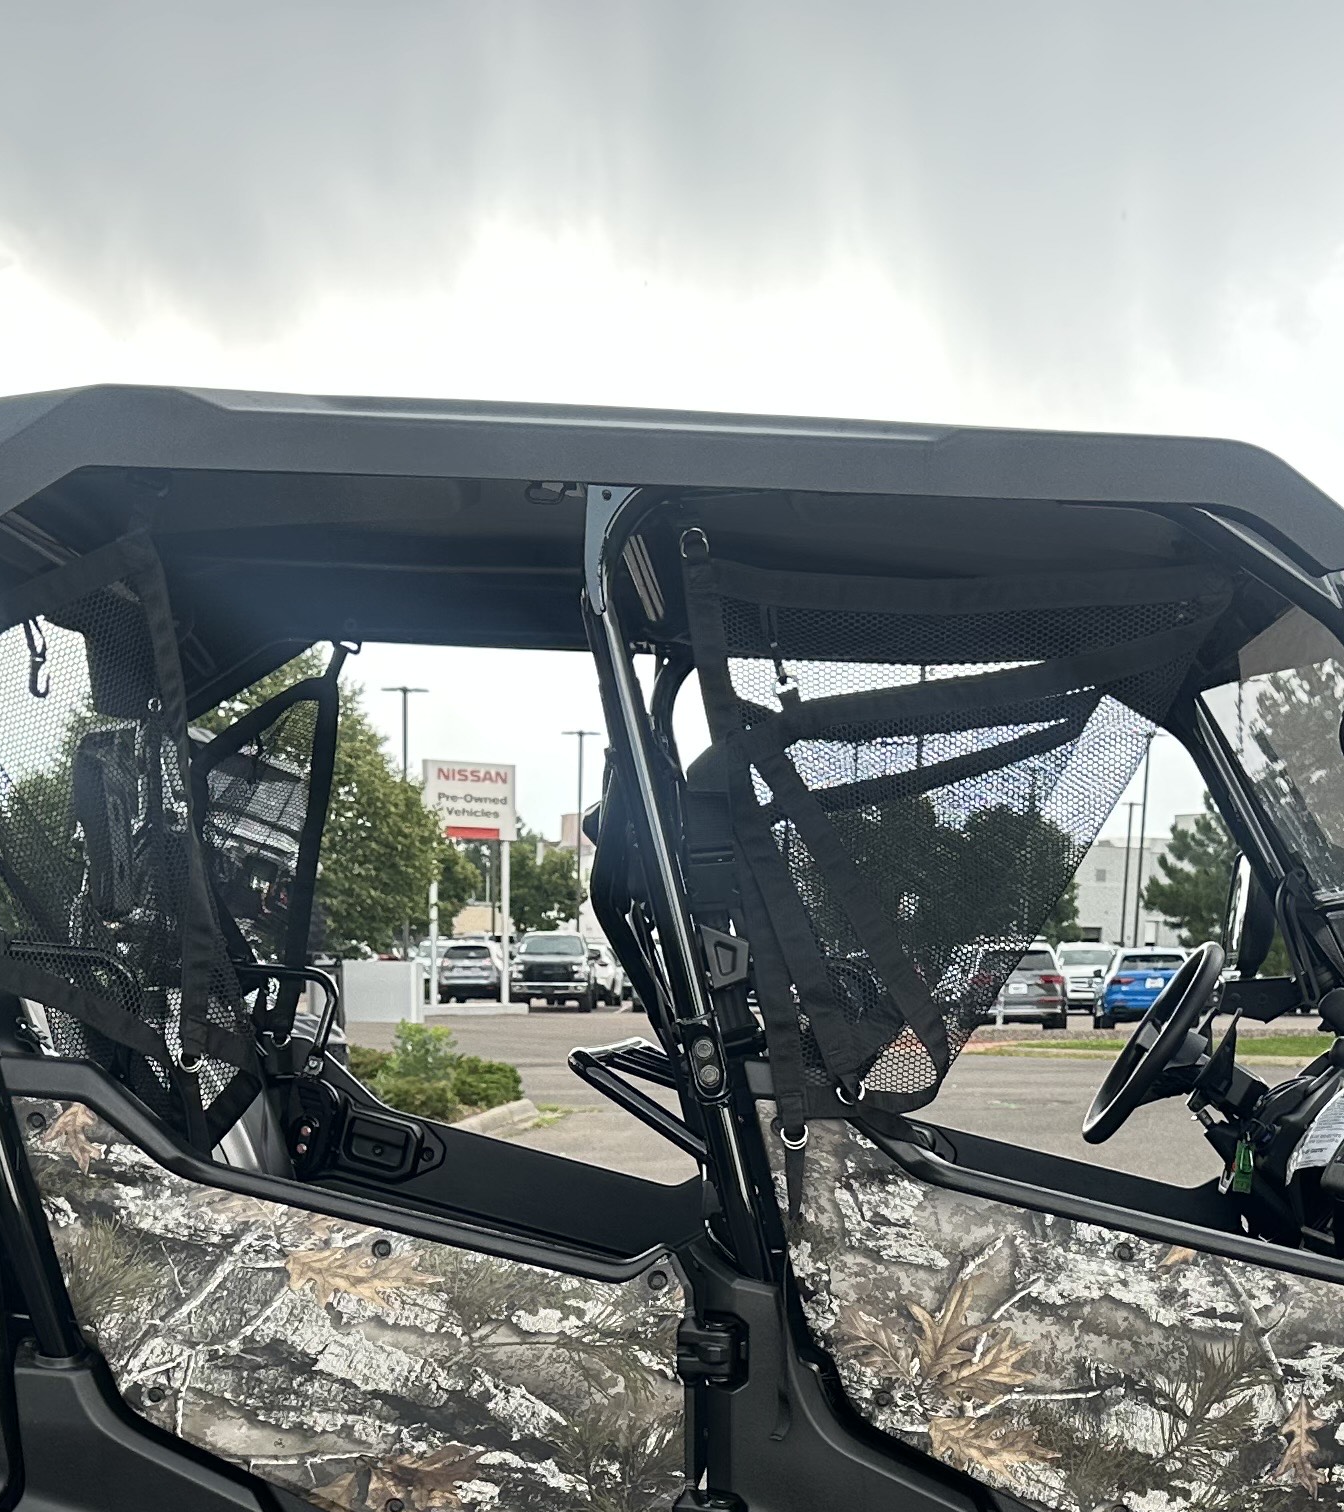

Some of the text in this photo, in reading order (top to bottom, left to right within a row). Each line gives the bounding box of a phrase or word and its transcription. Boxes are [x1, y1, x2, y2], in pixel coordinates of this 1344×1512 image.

[437, 767, 507, 784] NISSAN
[437, 792, 507, 805] Pre-Owned
[446, 806, 500, 818] Vehicles
